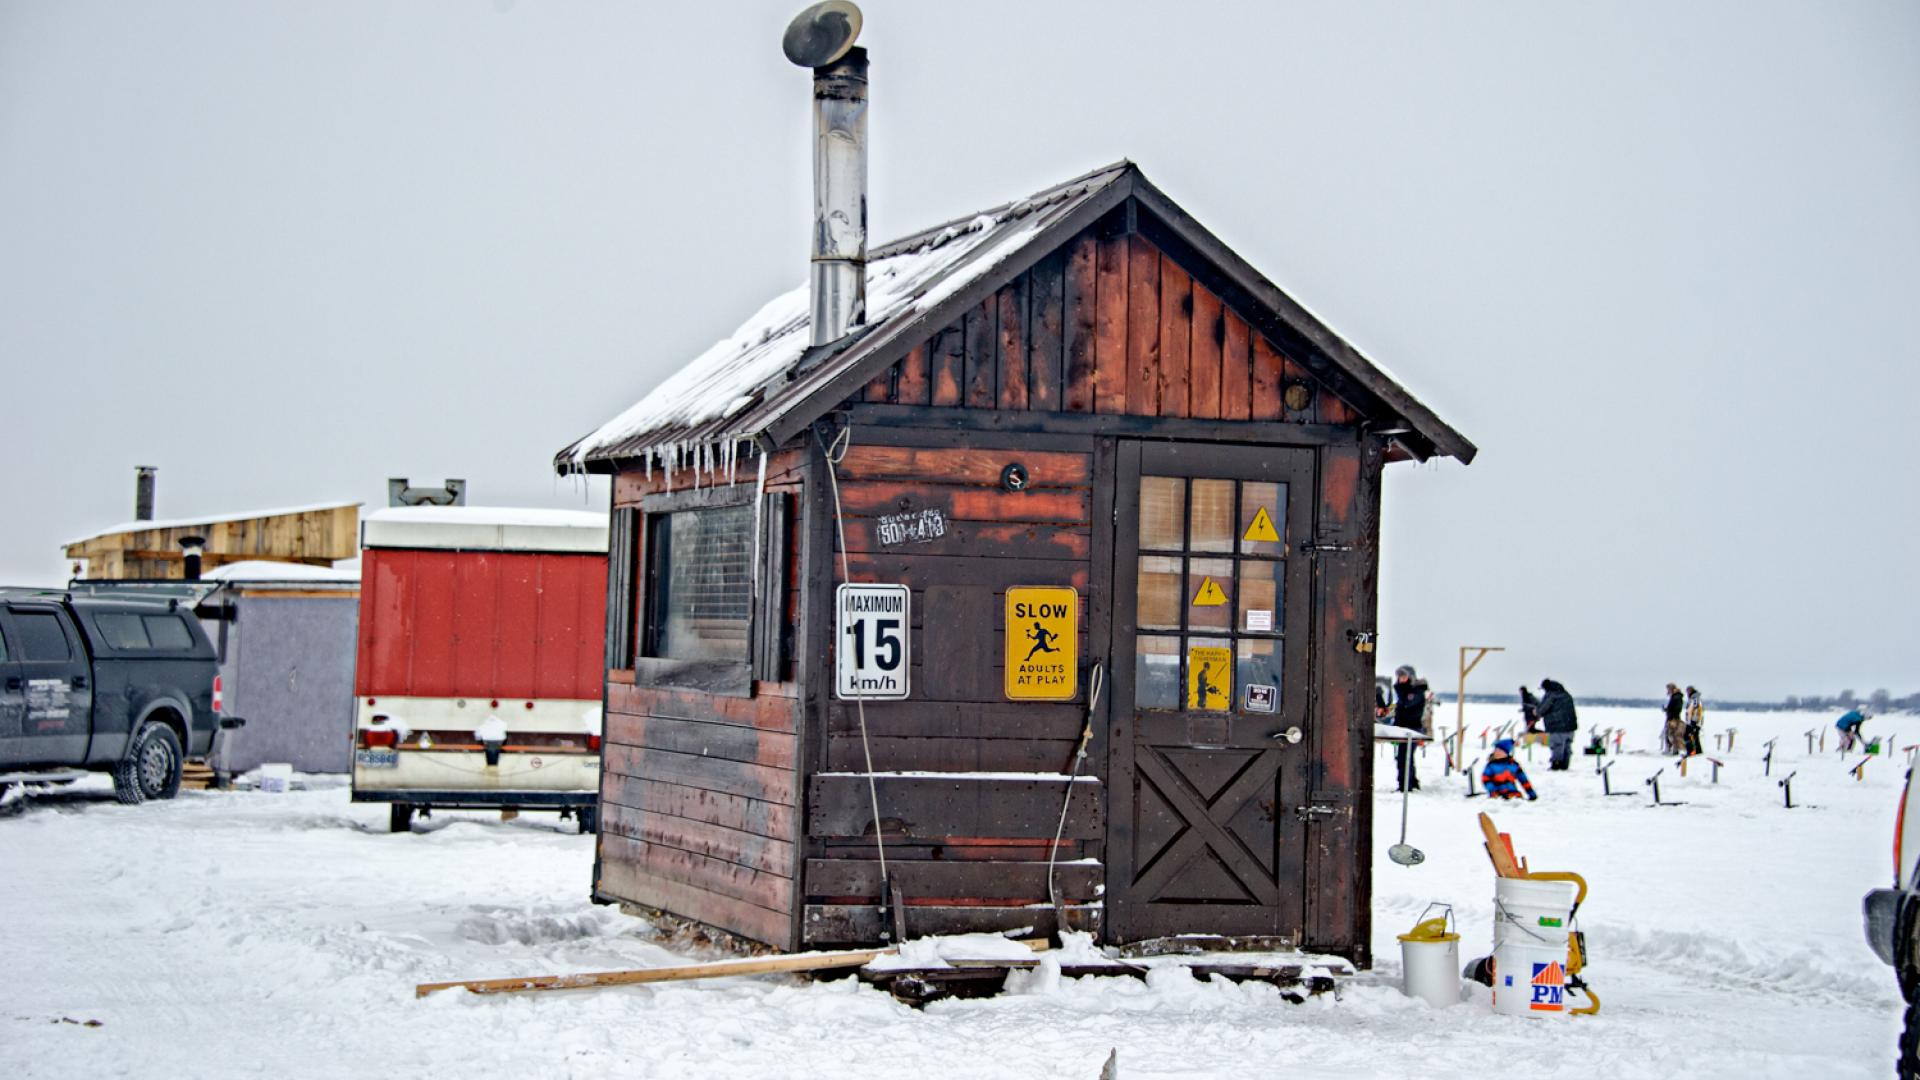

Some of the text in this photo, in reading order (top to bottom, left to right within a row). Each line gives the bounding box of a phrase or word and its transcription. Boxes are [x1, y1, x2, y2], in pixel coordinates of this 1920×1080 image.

[845, 595, 902, 612] MAXIMUM
[1015, 603, 1067, 618] SLOW
[846, 618, 902, 671] 15
[1019, 664, 1065, 673] ADULTS
[850, 675, 896, 690] km/h
[1018, 675, 1066, 684] AT PLAY
